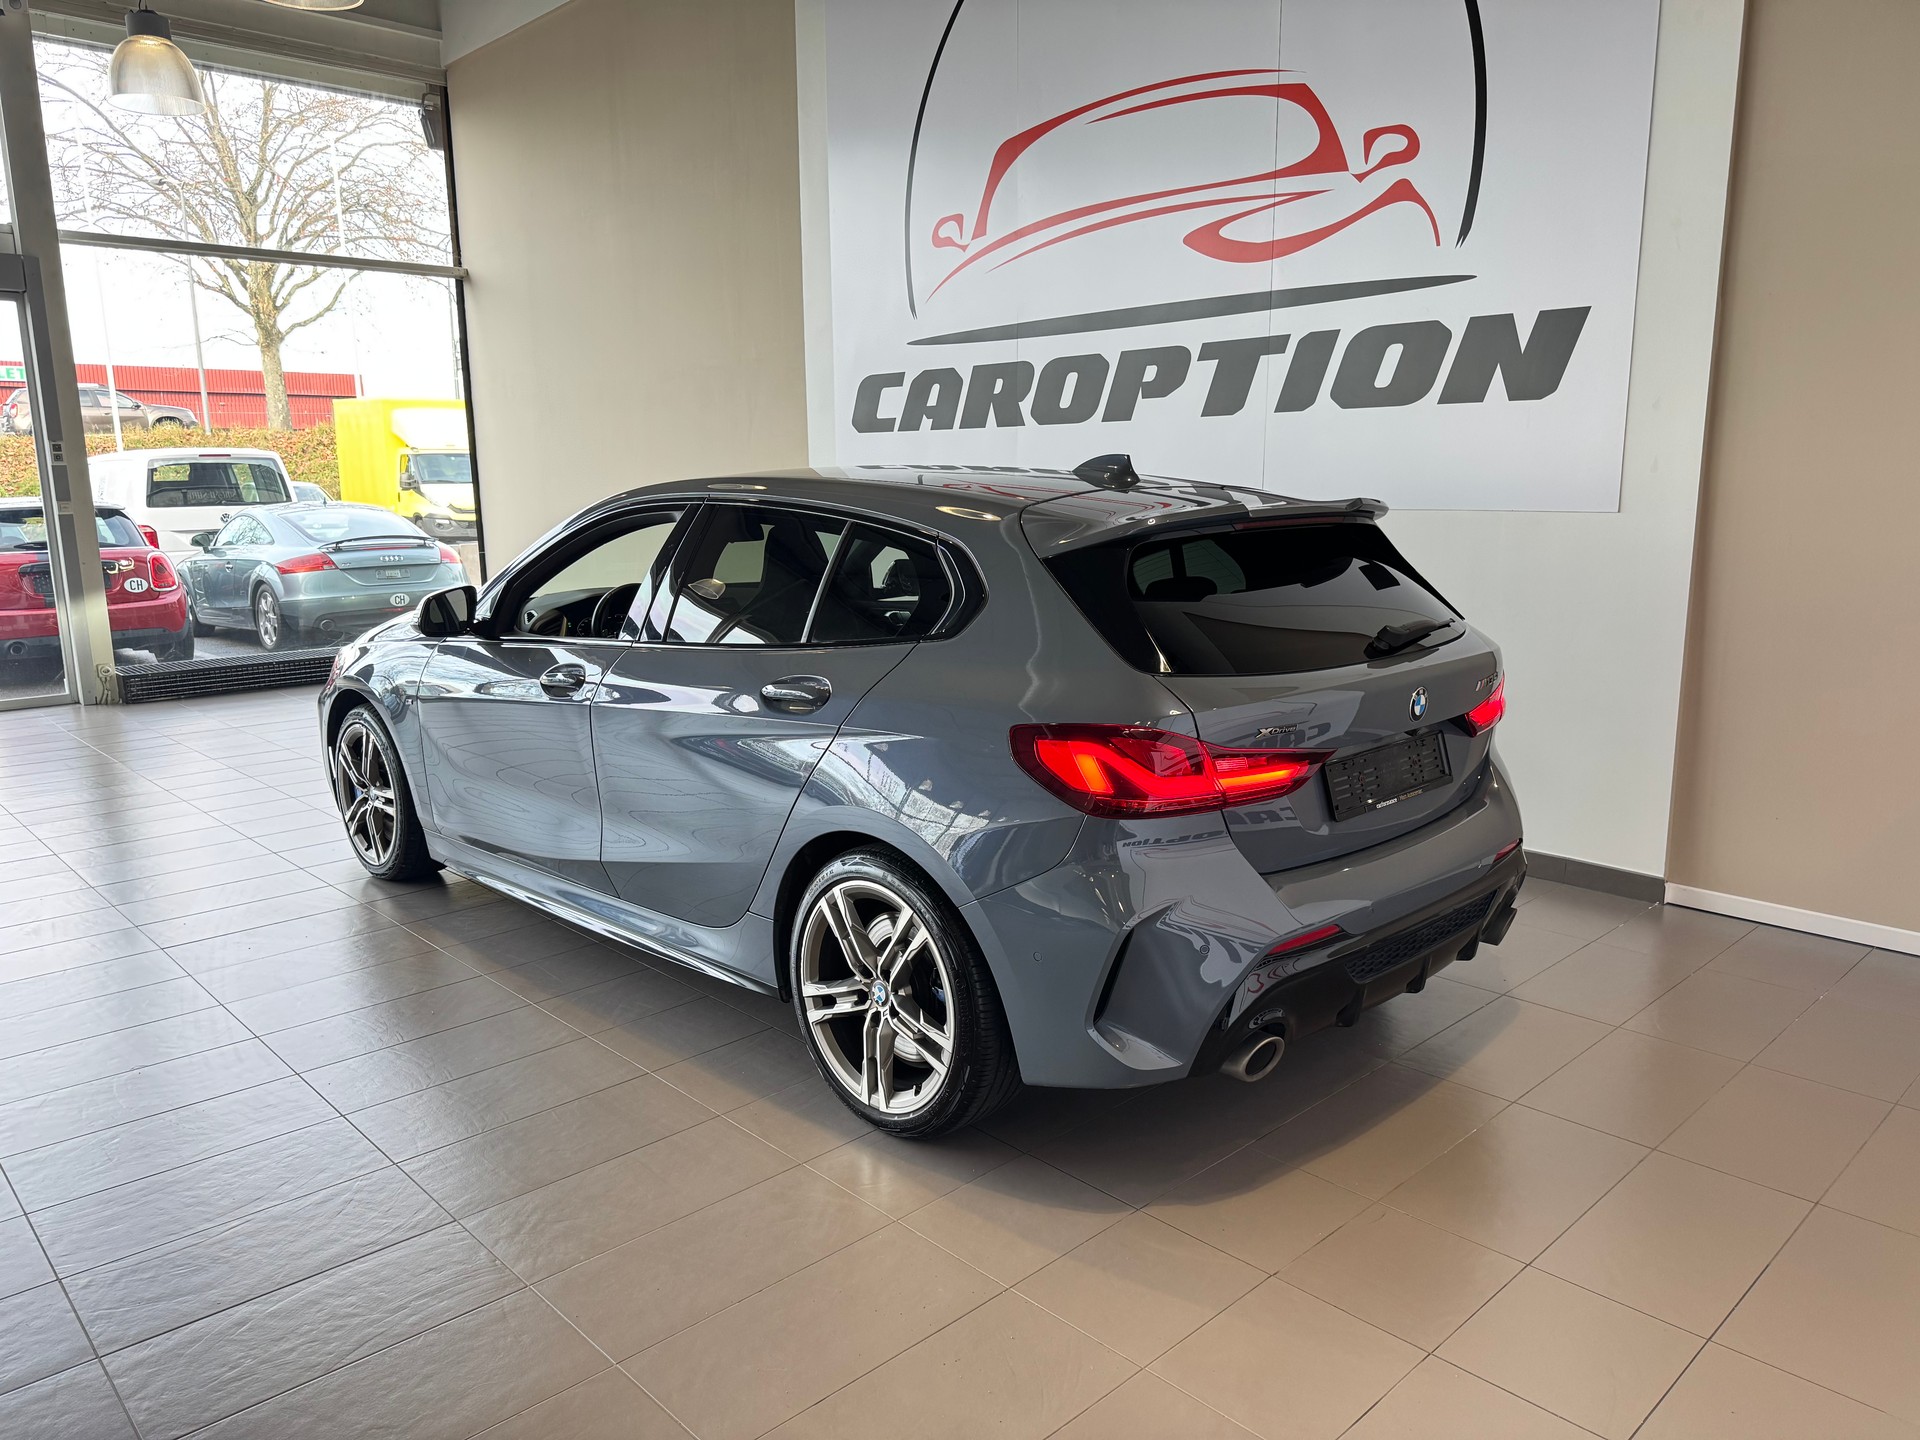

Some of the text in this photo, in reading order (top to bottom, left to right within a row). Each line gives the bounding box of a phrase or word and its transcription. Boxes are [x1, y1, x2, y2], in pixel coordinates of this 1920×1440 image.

[852, 306, 1592, 433] CAROPTION
[129, 580, 144, 591] CH
[394, 595, 405, 605] CH
